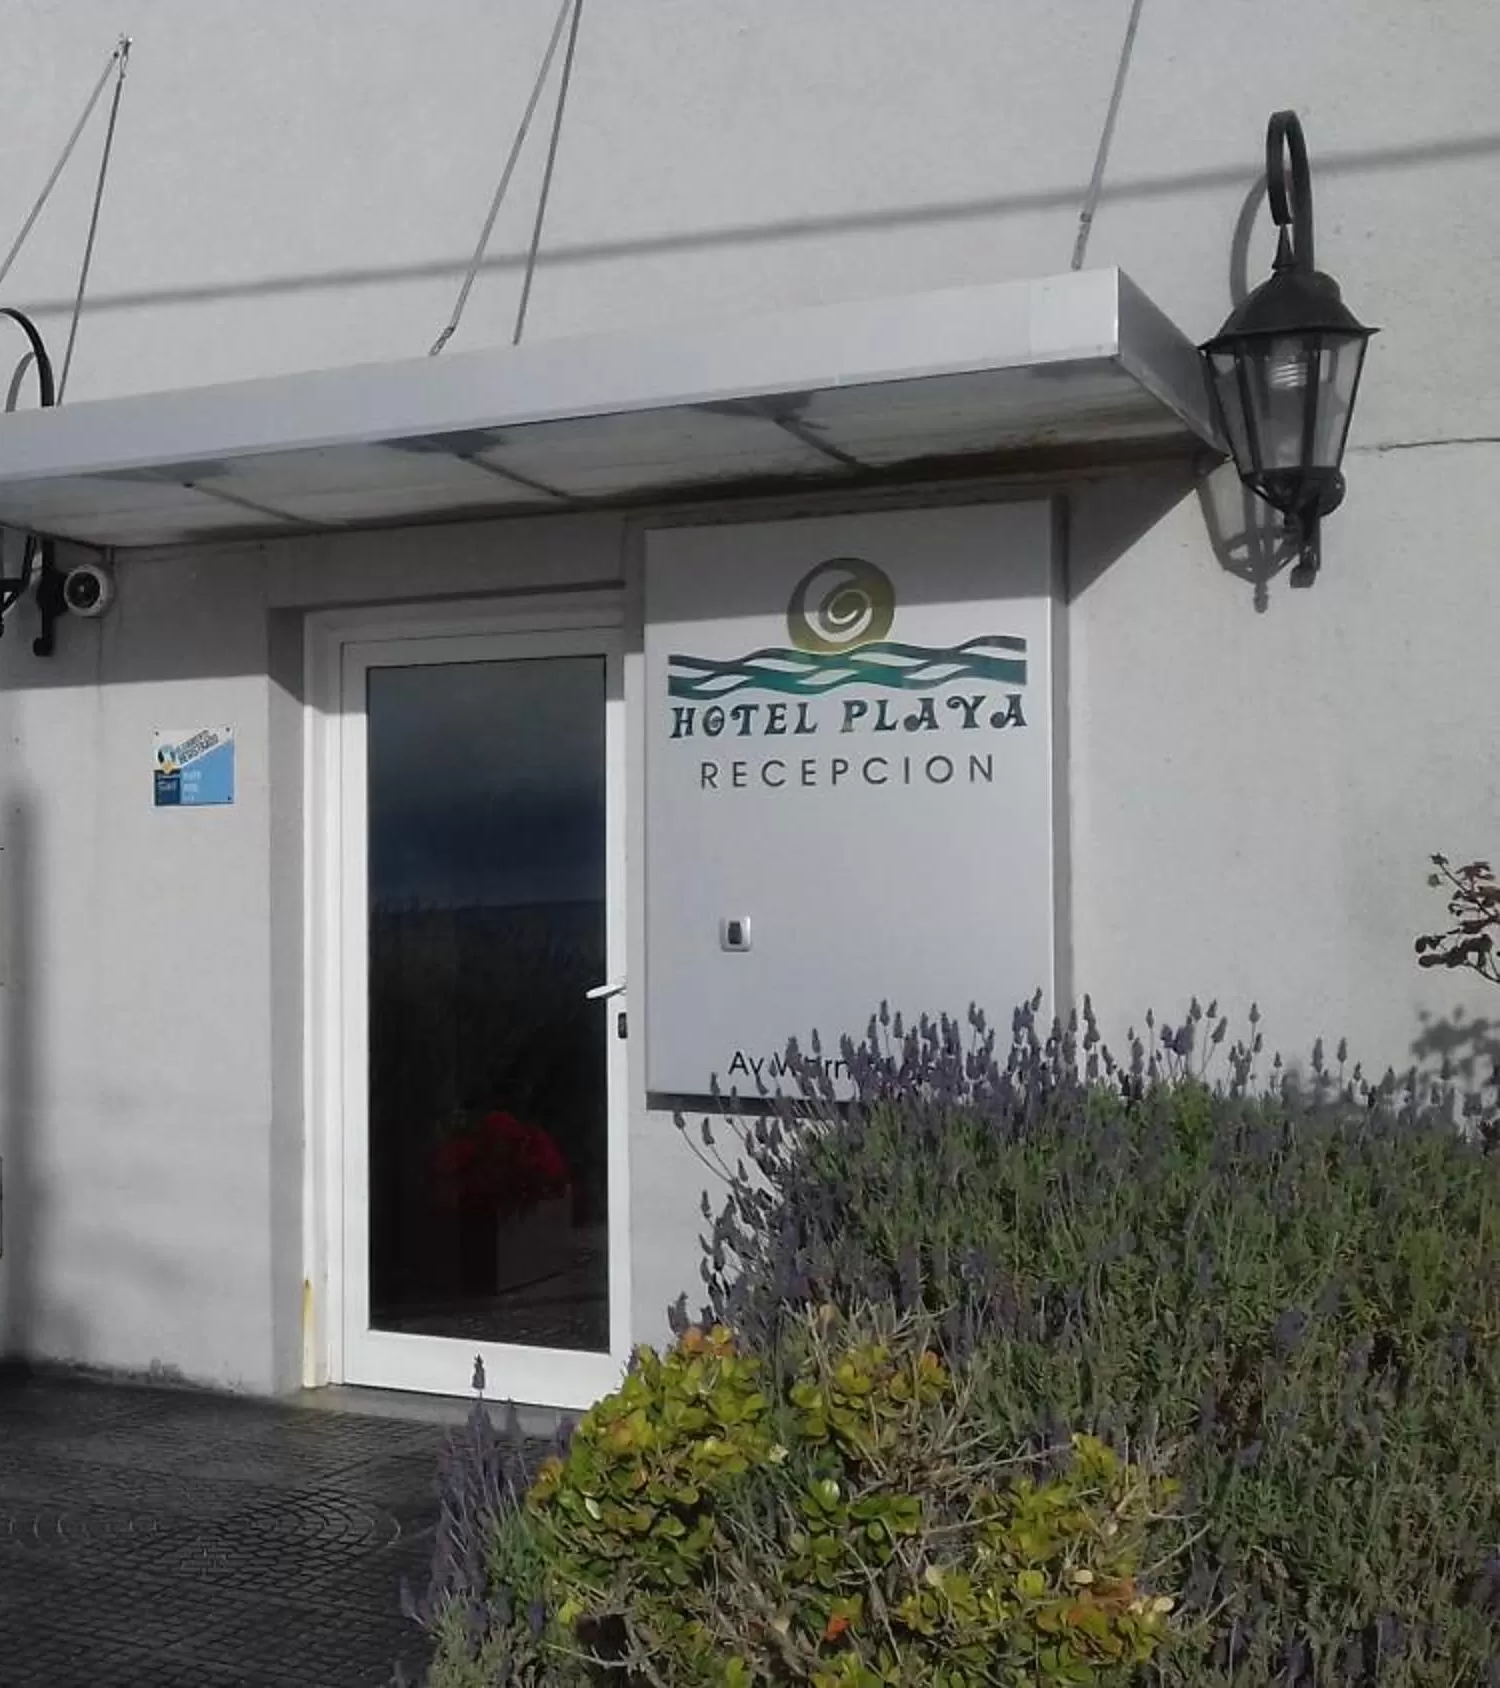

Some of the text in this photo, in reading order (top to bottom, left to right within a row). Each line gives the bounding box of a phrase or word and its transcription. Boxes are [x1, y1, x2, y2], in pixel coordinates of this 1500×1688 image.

[669, 694, 1028, 739] HOTEL PLAYA
[700, 754, 994, 789] RECEPCION
